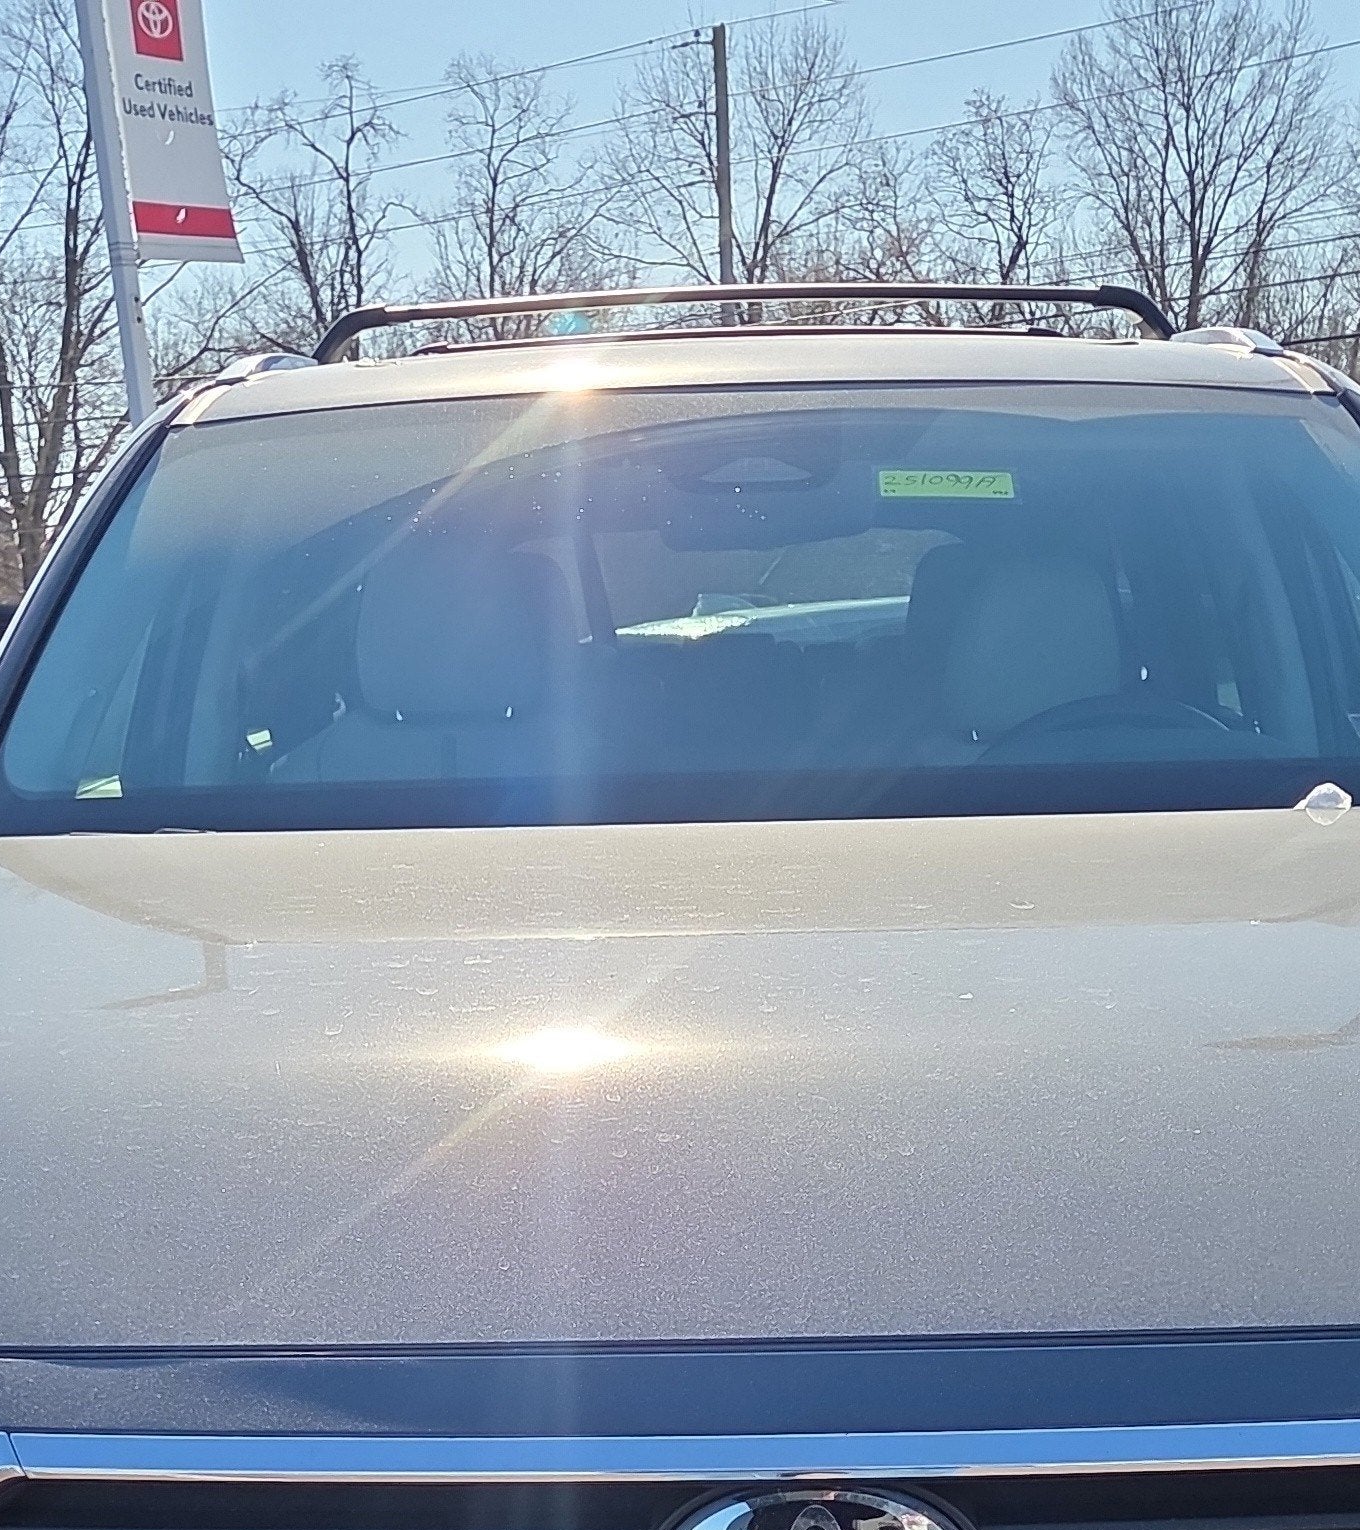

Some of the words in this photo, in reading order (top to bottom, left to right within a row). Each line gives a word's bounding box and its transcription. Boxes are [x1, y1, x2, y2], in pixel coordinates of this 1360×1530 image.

[134, 73, 193, 98] Certified
[123, 97, 155, 118] Used
[158, 102, 214, 126] Vehicles
